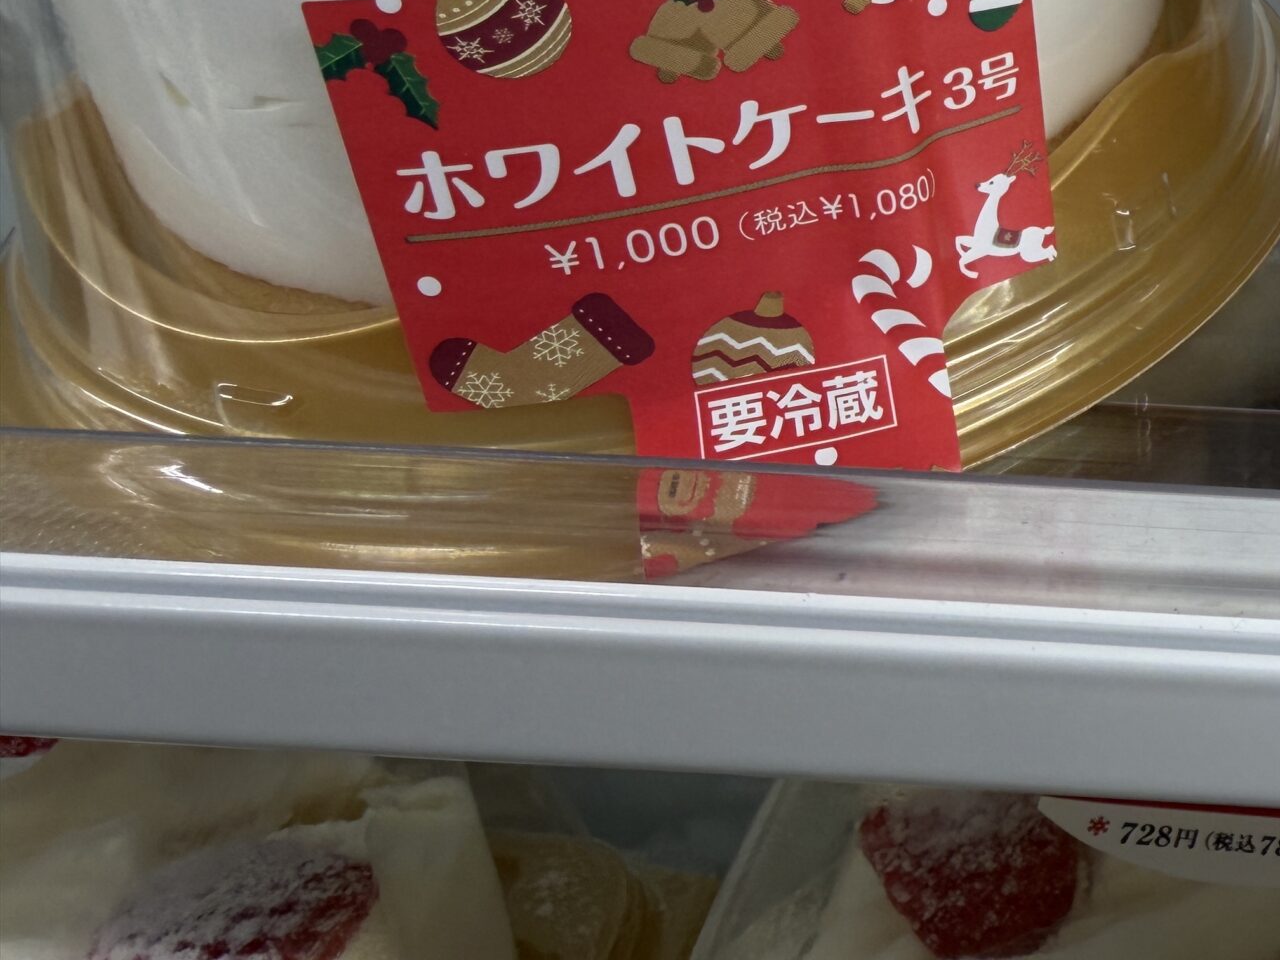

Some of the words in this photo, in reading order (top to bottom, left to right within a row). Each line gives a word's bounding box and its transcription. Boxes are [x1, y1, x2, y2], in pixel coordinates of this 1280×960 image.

[543, 215, 721, 276] ¥1,000
[707, 370, 884, 454] 要冷蔵
